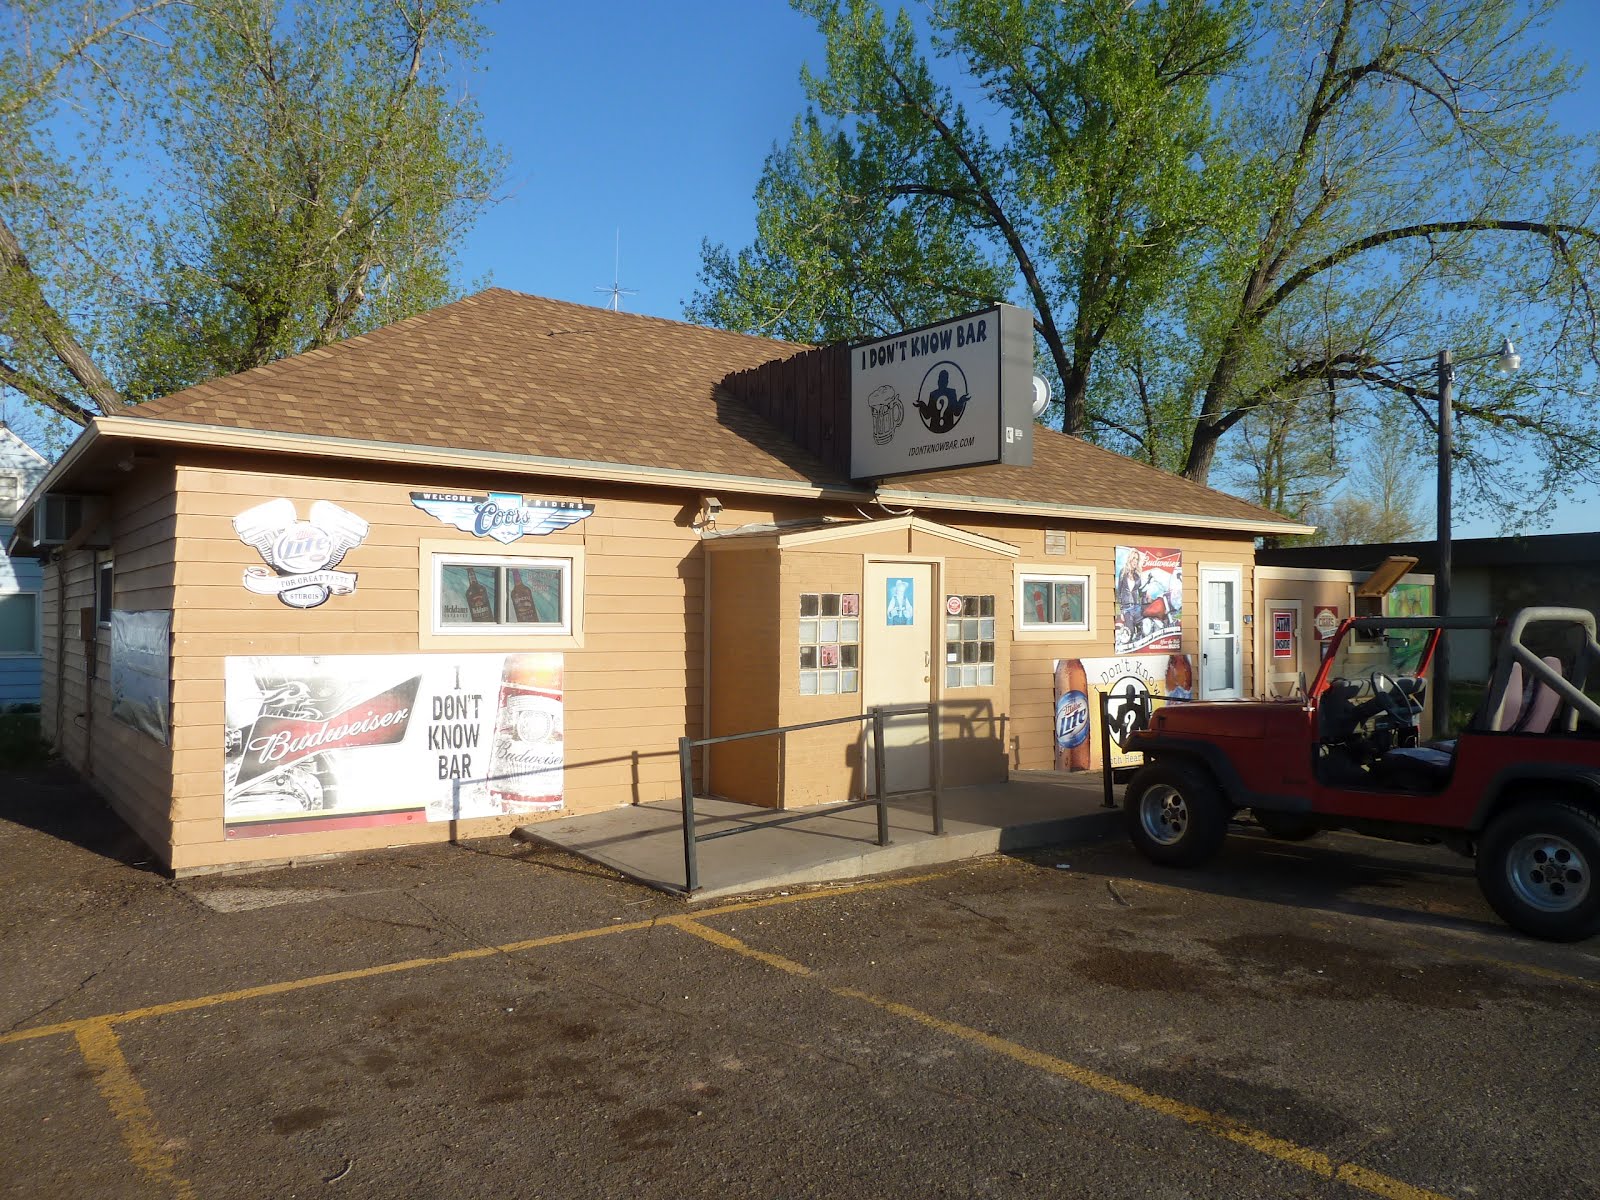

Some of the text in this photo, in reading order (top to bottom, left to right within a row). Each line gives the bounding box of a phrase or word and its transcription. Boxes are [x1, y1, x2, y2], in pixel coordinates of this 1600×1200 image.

[862, 319, 988, 370] I DON'T KNOW BAR
[908, 437, 975, 456] IDONTKNOWBAR.COM
[423, 493, 584, 509] WELCOME RIDERS
[474, 501, 530, 535] Coors
[282, 537, 328, 560] Lite
[1141, 555, 1180, 568] Budweiser
[281, 579, 297, 588] FOR
[298, 575, 323, 586] GREAT
[1276, 617, 1290, 631] ATM
[1275, 640, 1290, 649] INSIDE
[454, 665, 461, 690] I
[1100, 659, 1130, 686] Don't
[1135, 661, 1160, 695] Know
[432, 695, 482, 721] DON'T
[1062, 702, 1082, 715] Miller
[1059, 708, 1086, 738] Lite
[249, 707, 409, 764] Budweiser
[428, 723, 480, 750] KNOW
[438, 753, 472, 780] BAR
[1100, 755, 1122, 766] Sth
